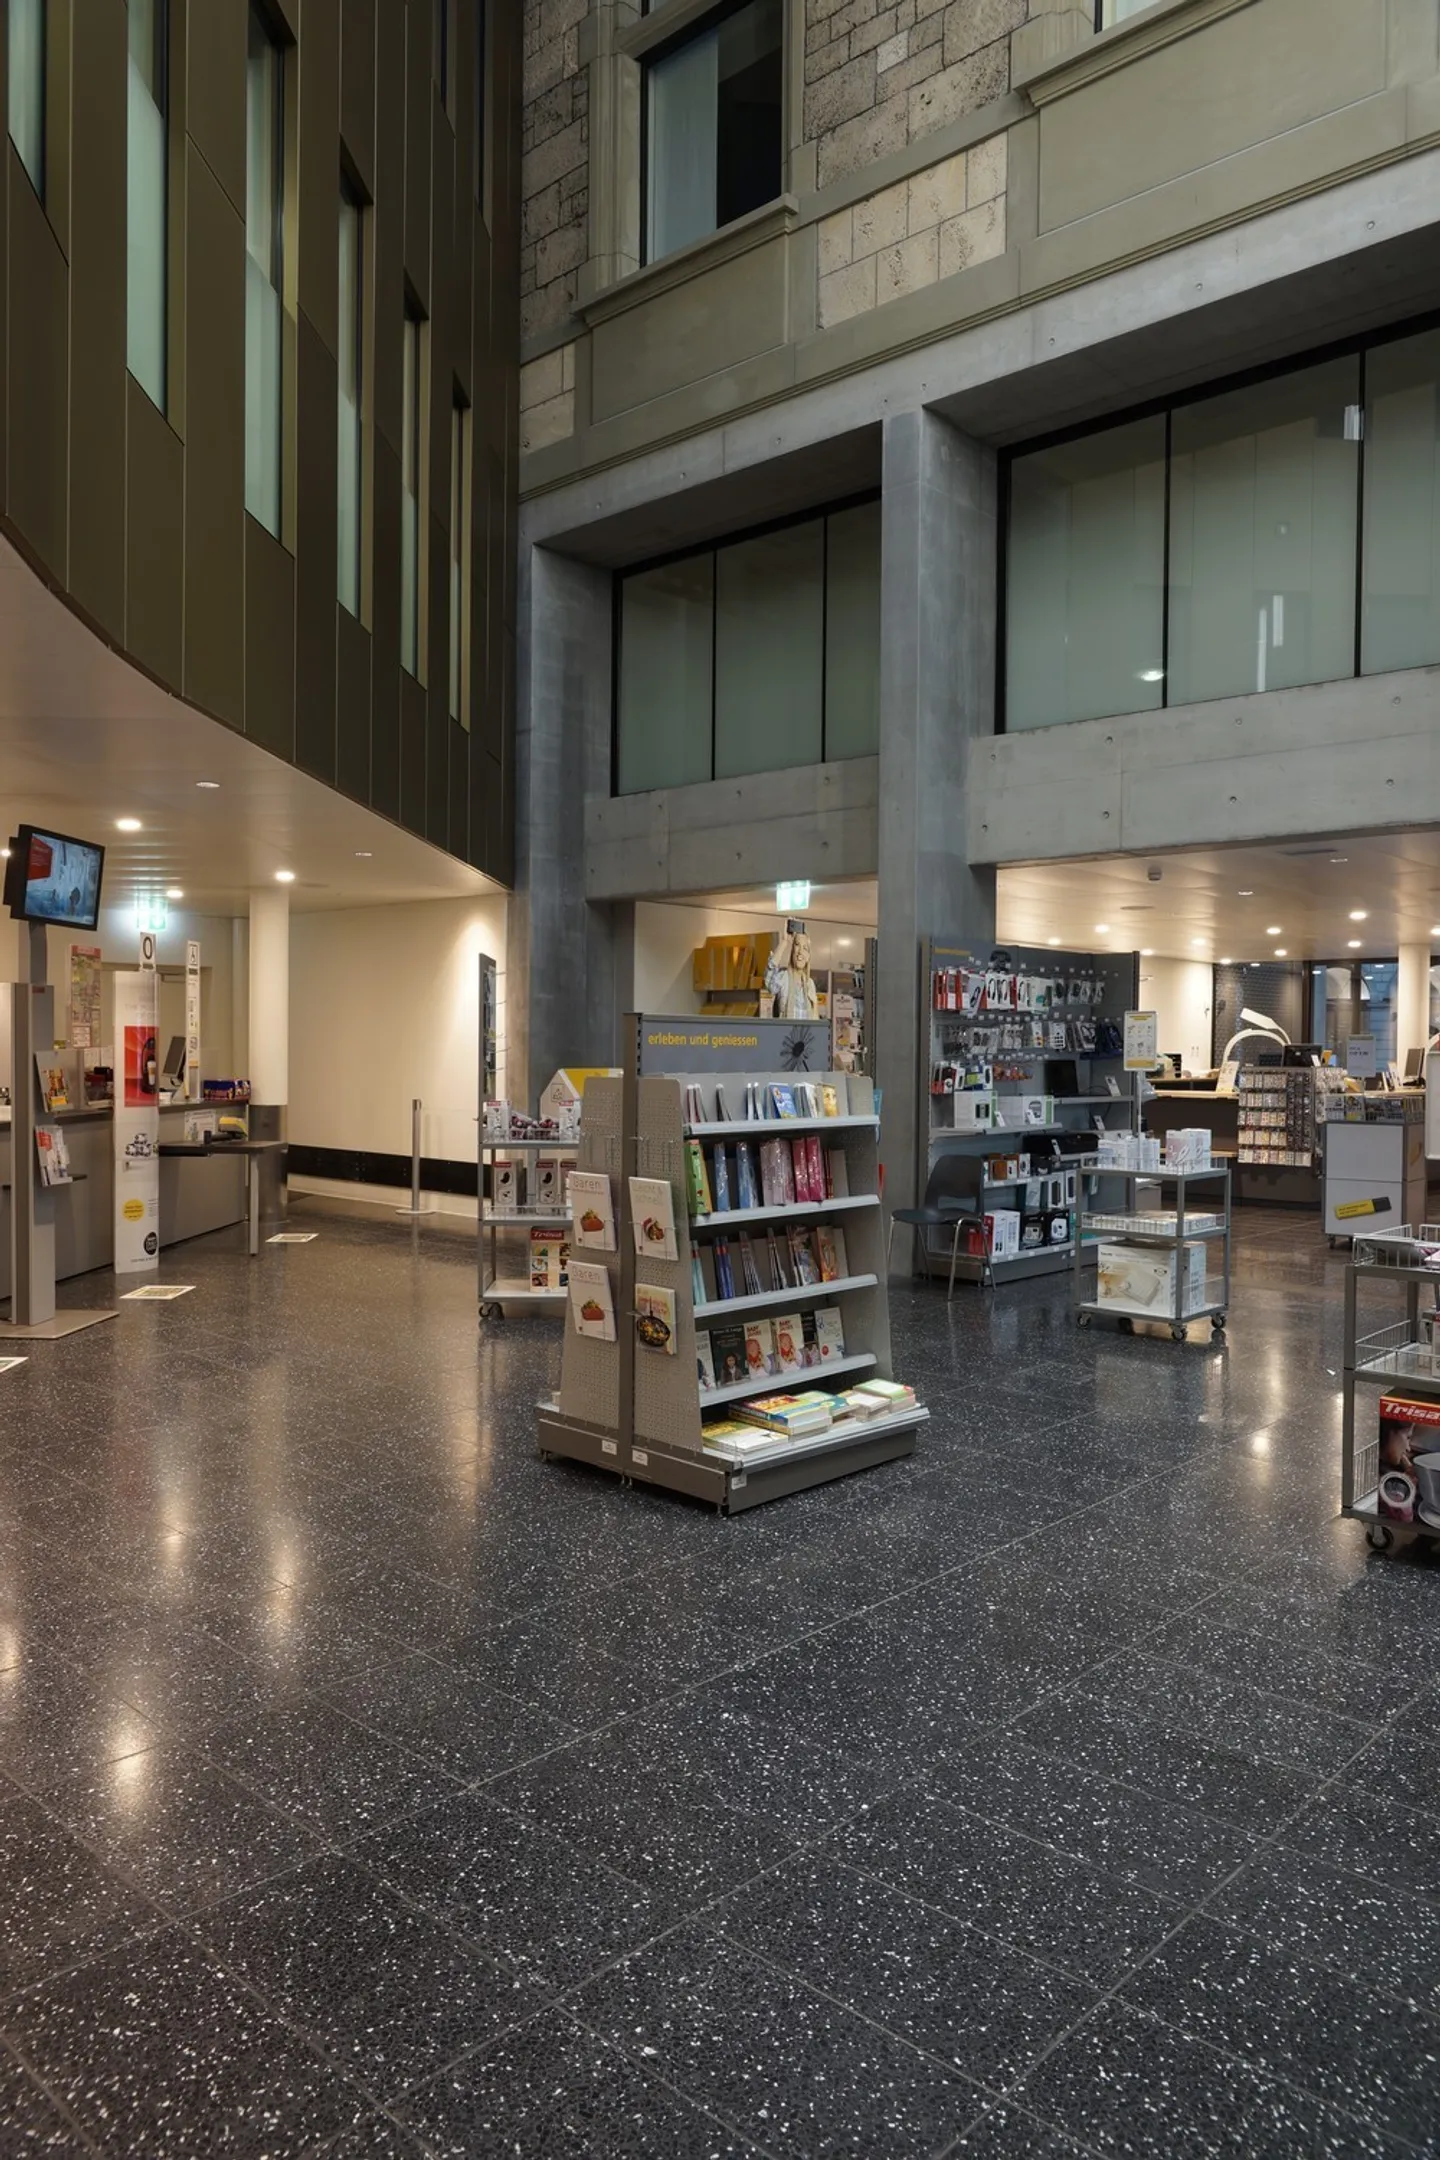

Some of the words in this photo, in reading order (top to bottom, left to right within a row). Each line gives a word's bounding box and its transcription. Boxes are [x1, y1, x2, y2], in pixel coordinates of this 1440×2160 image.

[648, 1033, 687, 1045] erleben
[689, 1033, 710, 1046] und
[712, 1034, 757, 1048] geniessen
[1382, 1401, 1440, 1419] Trisa
